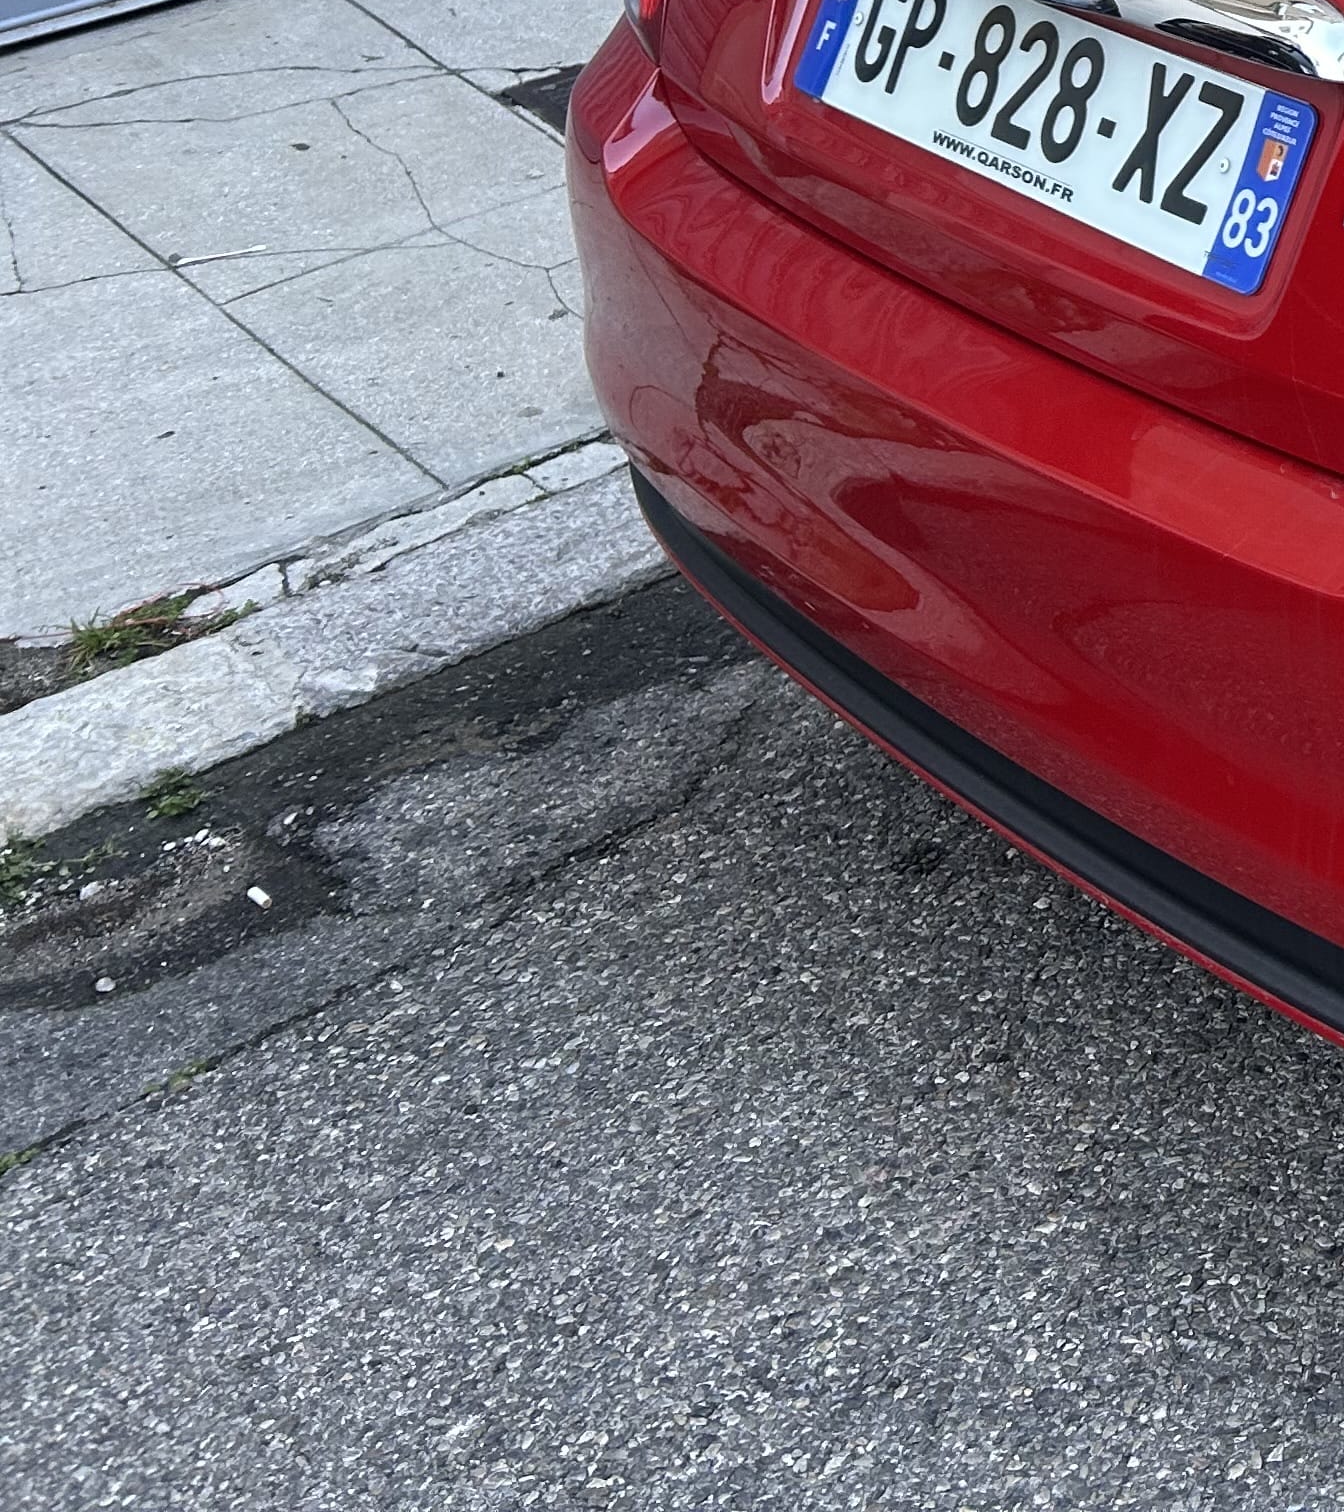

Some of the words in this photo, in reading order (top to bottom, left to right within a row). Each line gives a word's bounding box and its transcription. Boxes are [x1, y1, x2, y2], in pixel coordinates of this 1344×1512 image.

[815, 19, 838, 51] F
[932, 130, 1075, 203] WWW.QARSON.FR
[1222, 188, 1279, 258] 83
